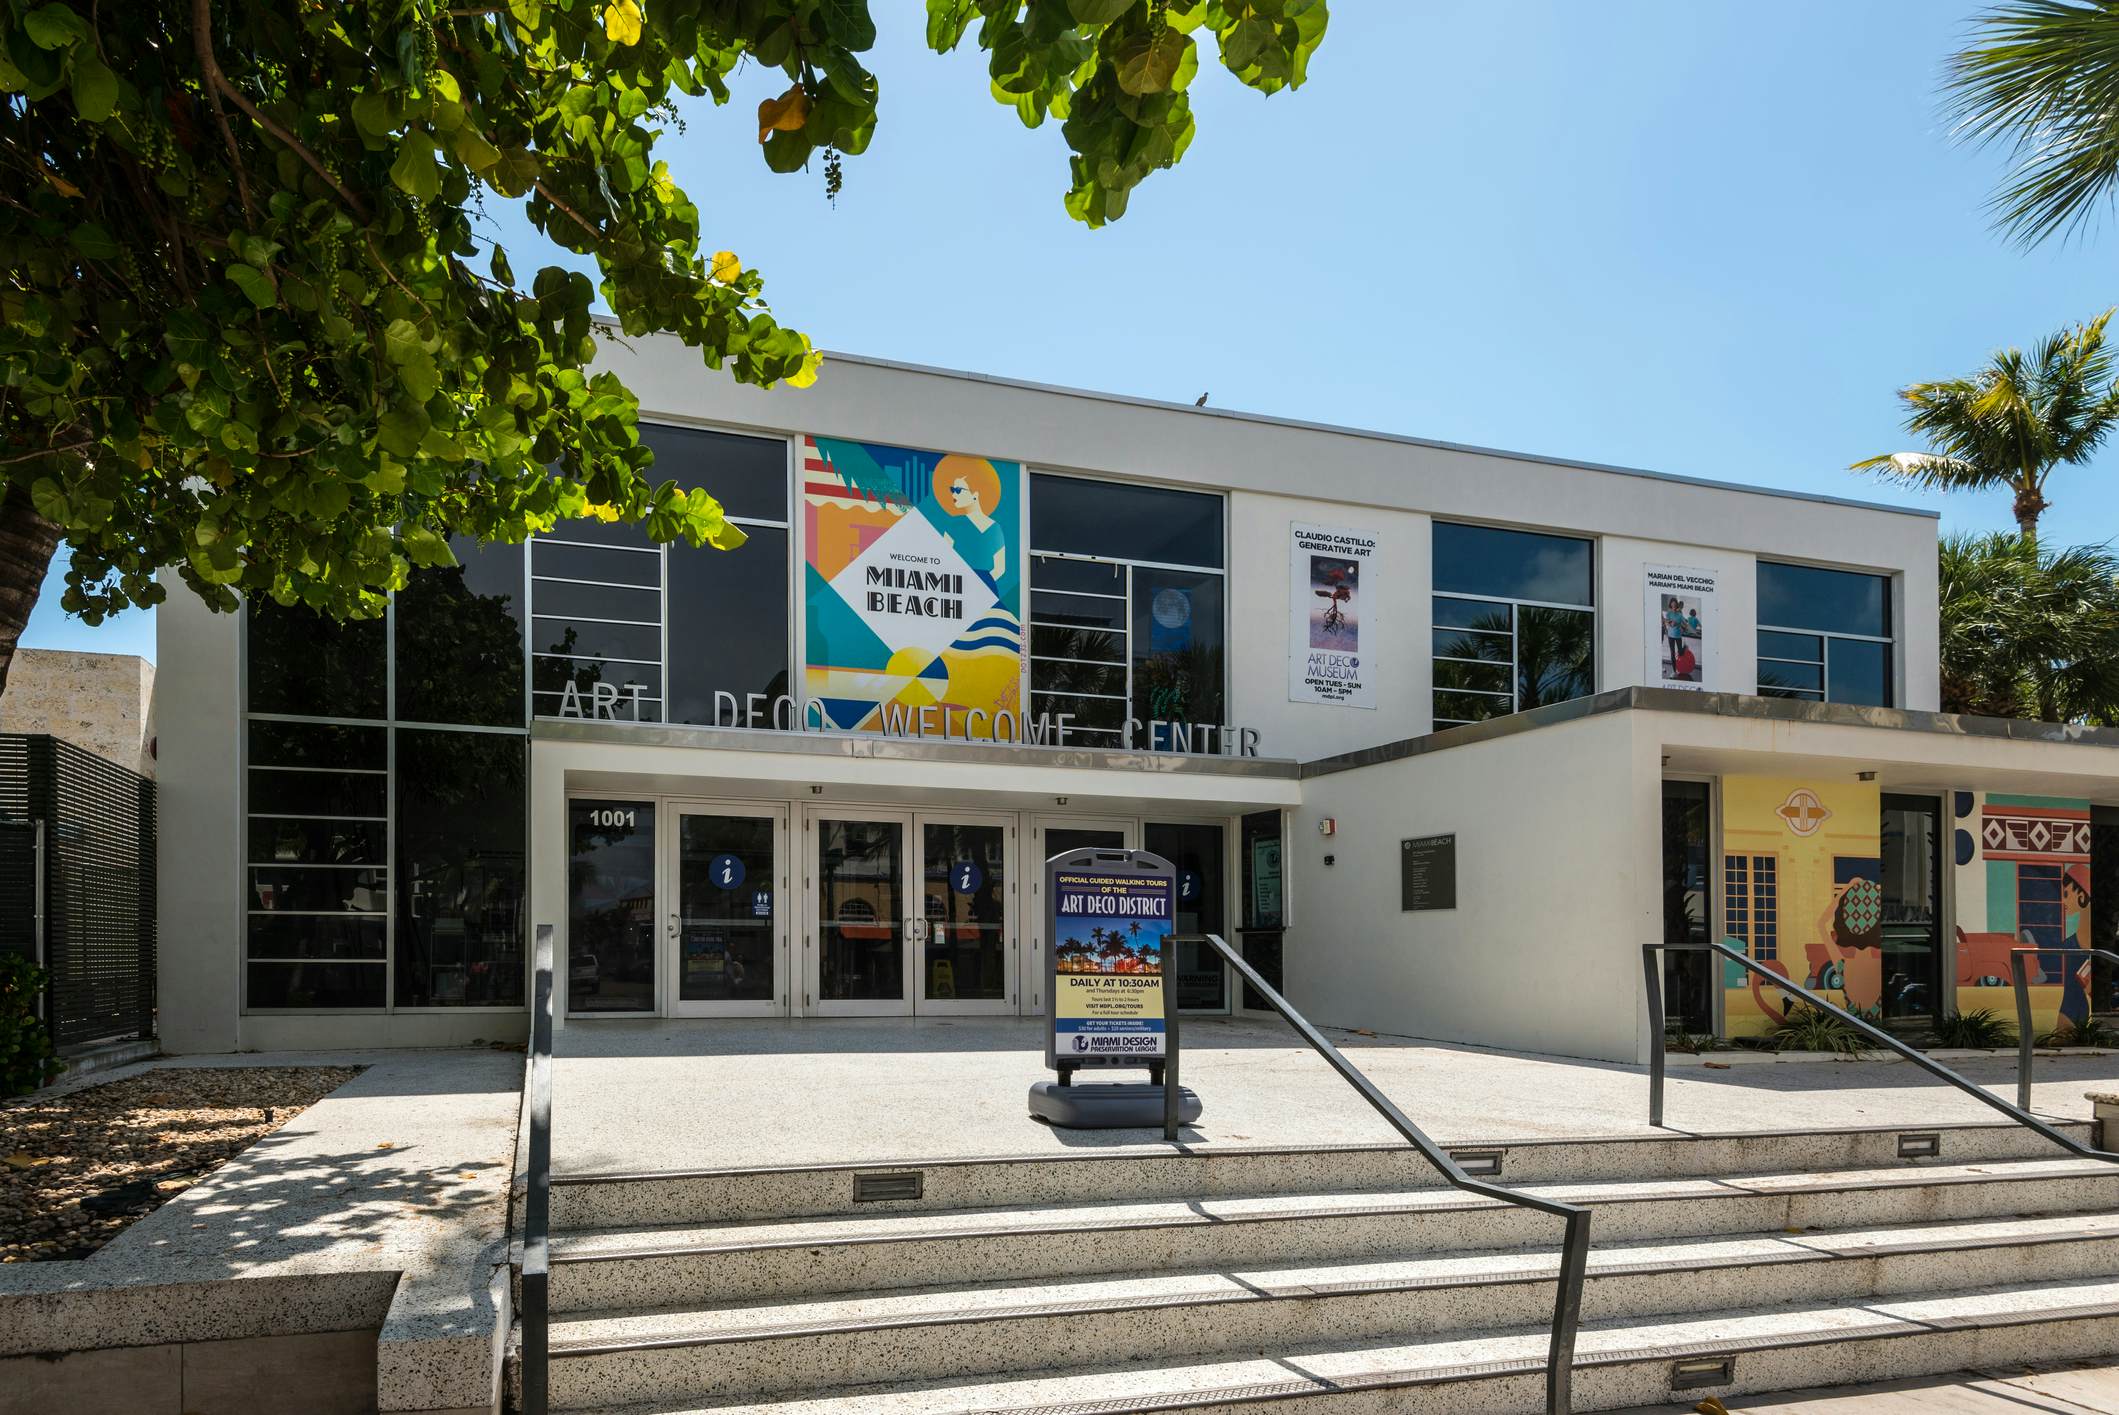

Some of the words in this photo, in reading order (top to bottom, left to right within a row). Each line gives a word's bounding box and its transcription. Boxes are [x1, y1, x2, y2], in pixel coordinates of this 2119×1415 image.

[1294, 530, 1332, 543] CLAUDIO
[1333, 535, 1376, 548] CASTILLO:
[1298, 541, 1352, 555] GENERATIVE
[1353, 547, 1371, 557] ART
[889, 552, 928, 565] WELCOME
[929, 556, 941, 566] TO
[865, 565, 963, 595] MIAMI
[1647, 572, 1672, 581] MARIAN
[1673, 574, 1685, 582] DEL
[1685, 576, 1715, 586] VECCHIO:
[1648, 580, 1676, 589] MARIAN'S
[1676, 583, 1694, 591] MIAMI
[1694, 585, 1714, 593] BEACH
[866, 591, 963, 620] BEACH
[1307, 652, 1327, 665] ART
[1328, 654, 1360, 669] DECO
[1307, 666, 1358, 681] MUSEUM
[1304, 678, 1324, 686] OPEN
[1325, 680, 1343, 688] TUES
[1347, 682, 1362, 690] SUN
[1314, 686, 1332, 694] 10AM
[1338, 688, 1353, 696] 5PM
[559, 680, 648, 722] ART
[713, 690, 827, 733] DECO
[878, 701, 1076, 746] WELCOME
[1121, 717, 1263, 757] CENTER
[589, 810, 636, 828] 1001
[1059, 876, 1089, 884] OFFICIAL
[1089, 877, 1114, 885] GUIDED
[1115, 878, 1145, 886] WALKING
[1146, 879, 1168, 887] TOURS
[1061, 894, 1084, 913] ART
[1087, 895, 1115, 914] DECO
[1119, 896, 1166, 916] DISTRICT
[1070, 978, 1100, 987] DAILY
[1103, 978, 1116, 987] AT
[1119, 979, 1160, 988] 10:30AM
[1091, 1037, 1121, 1046] MIAMI
[1122, 1037, 1158, 1046] DESIGN
